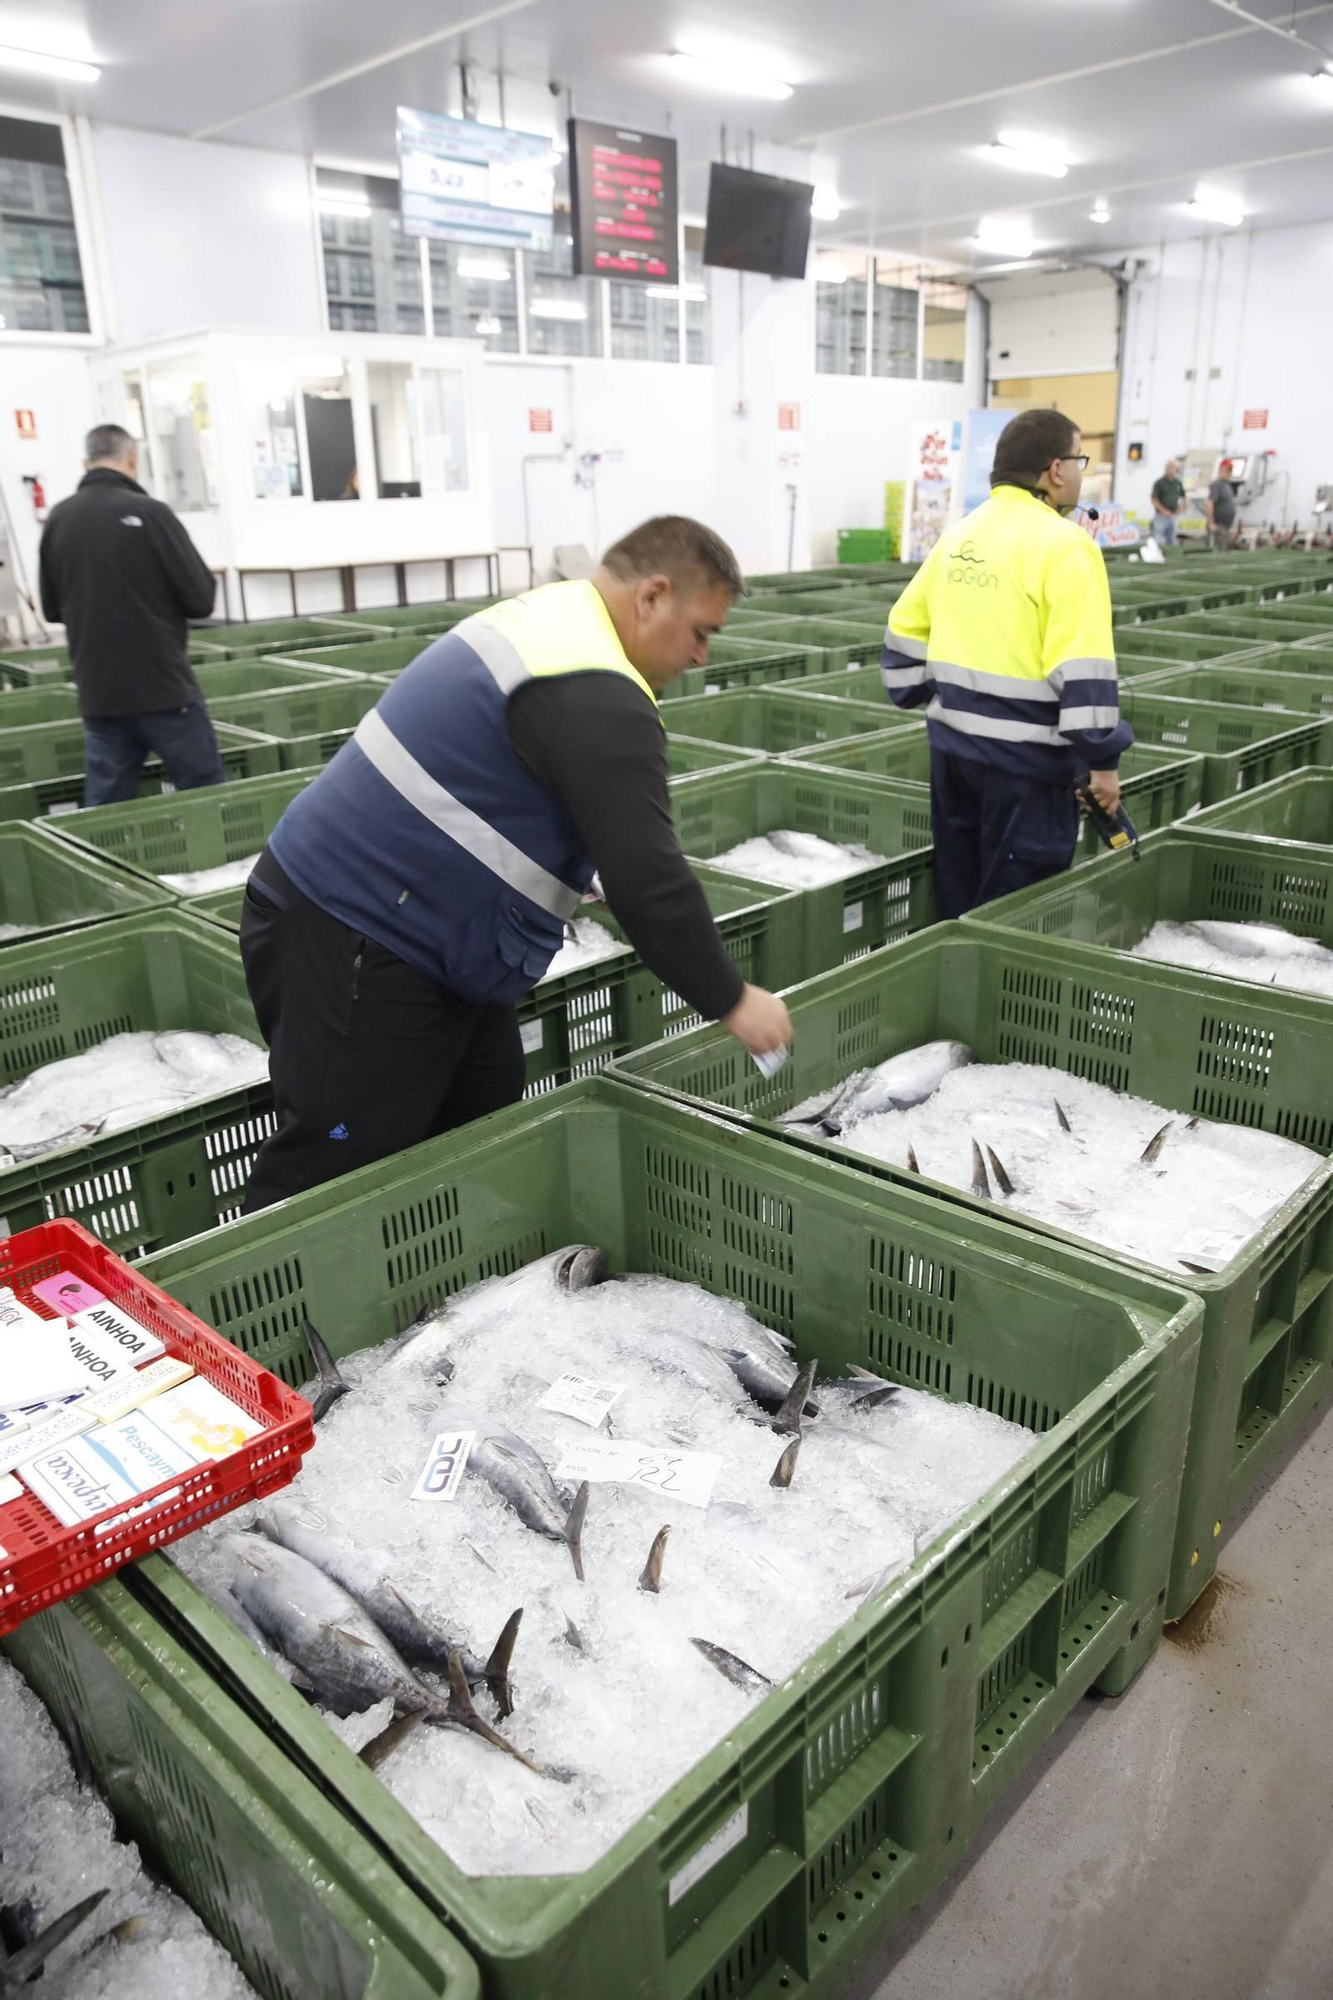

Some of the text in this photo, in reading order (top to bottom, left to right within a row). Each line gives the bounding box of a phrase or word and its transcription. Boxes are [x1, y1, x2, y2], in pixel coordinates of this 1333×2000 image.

[88, 1311, 146, 1354] AINHOA
[566, 1464, 589, 1473] KILOS
[628, 1466, 681, 1492] 122
